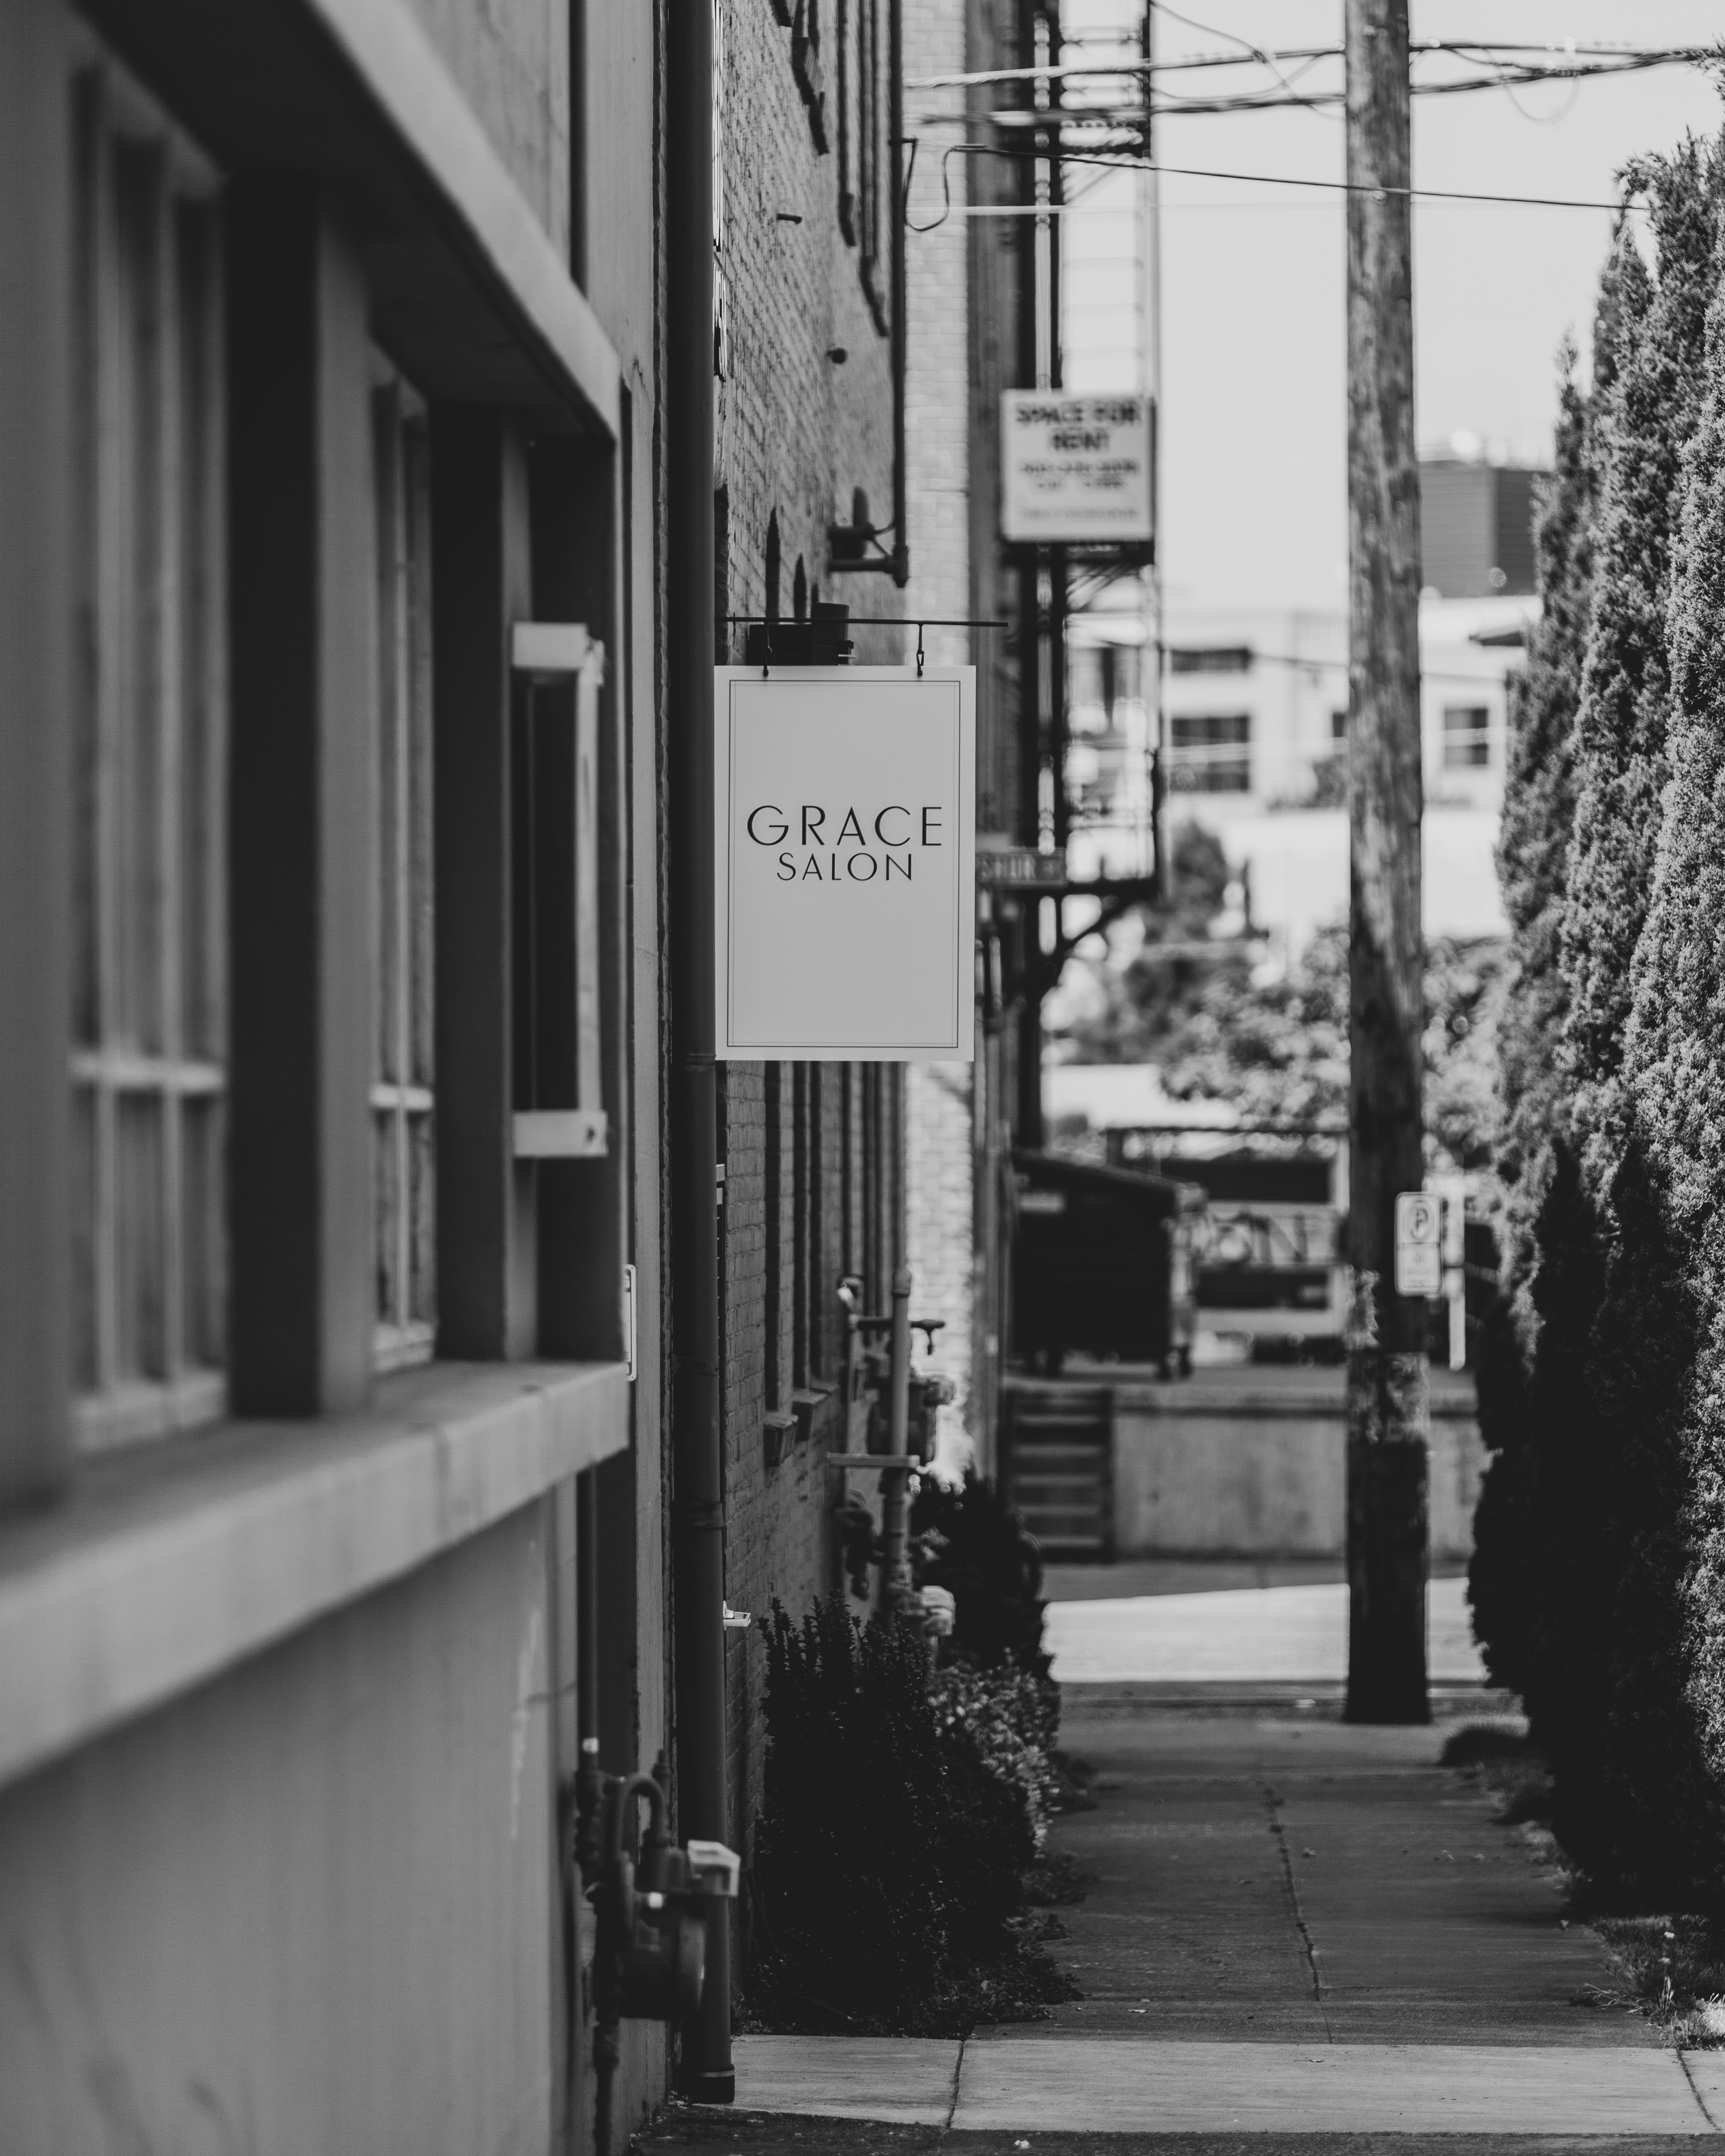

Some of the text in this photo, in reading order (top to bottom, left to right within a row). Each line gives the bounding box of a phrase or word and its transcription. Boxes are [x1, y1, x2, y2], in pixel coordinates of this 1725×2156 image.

[1015, 399, 1141, 424] SPACE FOR
[1051, 427, 1109, 451] RENT
[747, 805, 942, 847] GRACE
[776, 852, 912, 882] SALON
